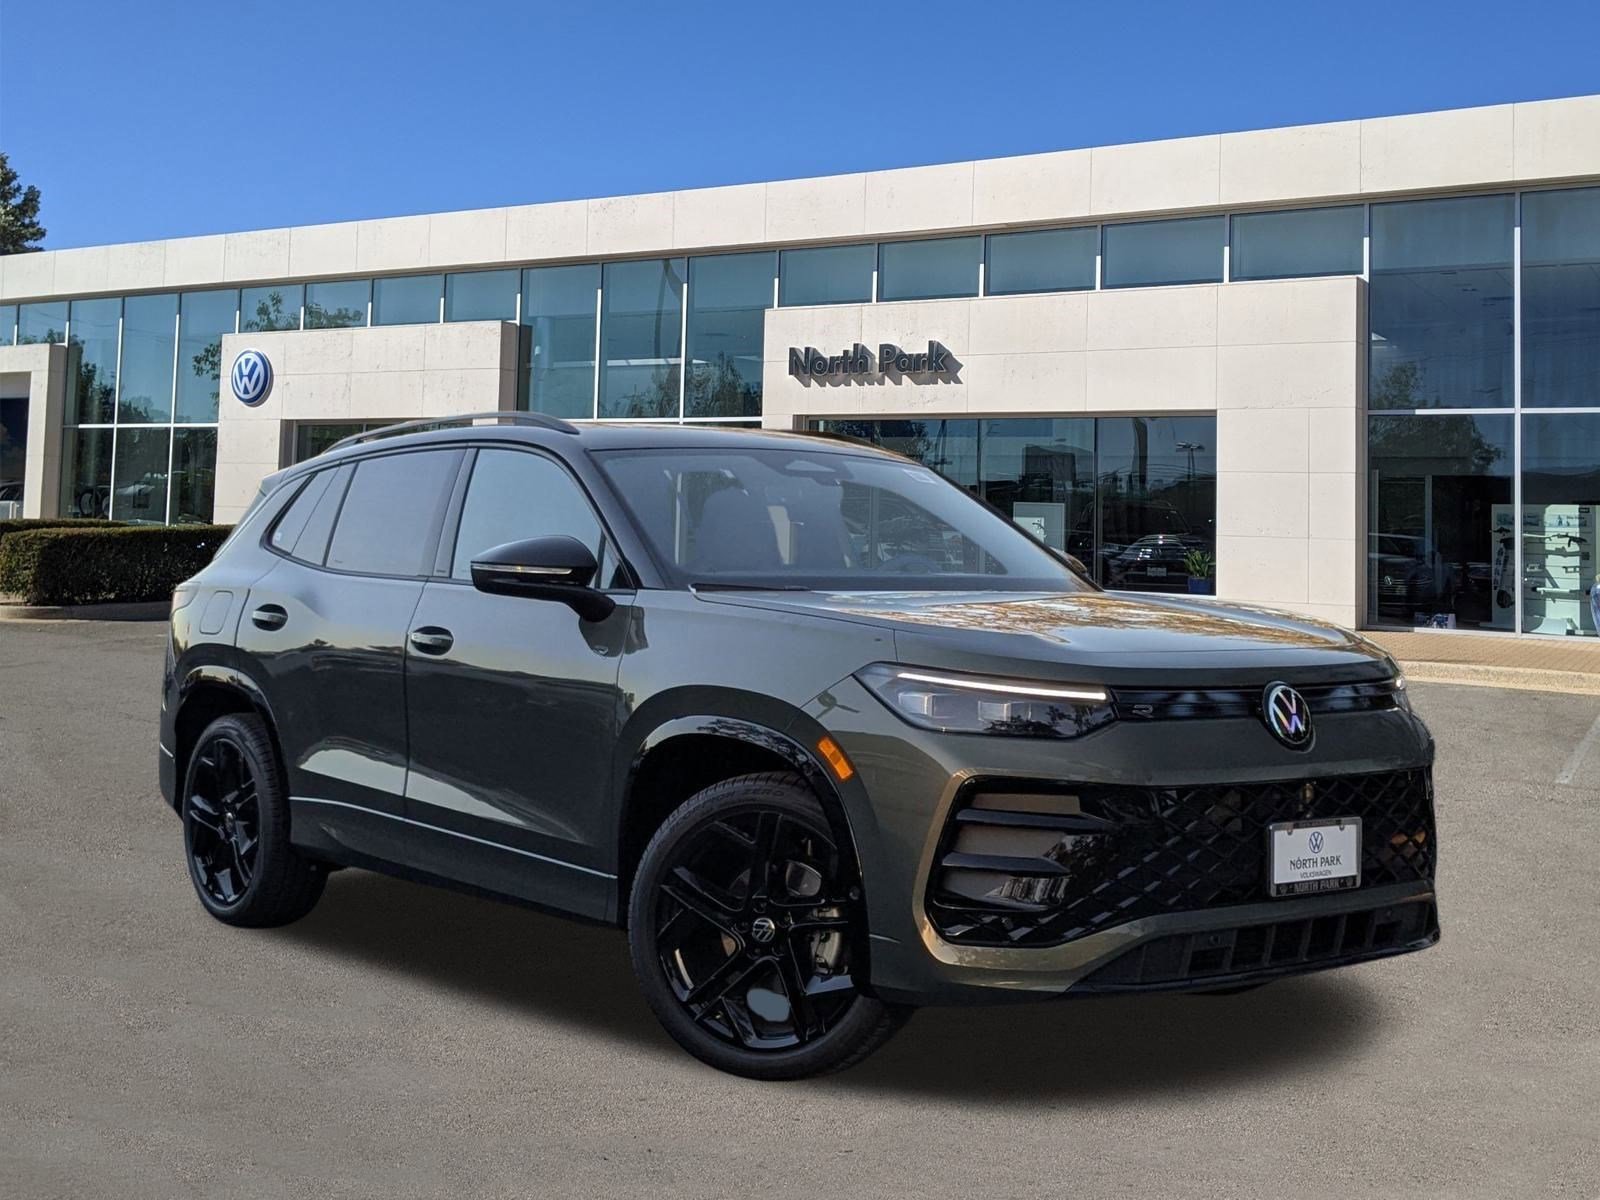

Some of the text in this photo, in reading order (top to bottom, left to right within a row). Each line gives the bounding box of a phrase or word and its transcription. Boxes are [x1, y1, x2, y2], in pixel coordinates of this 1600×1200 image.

[789, 340, 947, 375] North Park
[232, 351, 267, 401] VW
[1268, 684, 1312, 744] VW
[1308, 831, 1325, 854] VW
[1289, 854, 1343, 871] NORTH PARK
[1300, 869, 1332, 879] VOLKSWAGEN
[1294, 877, 1340, 894] NORTH PARK
